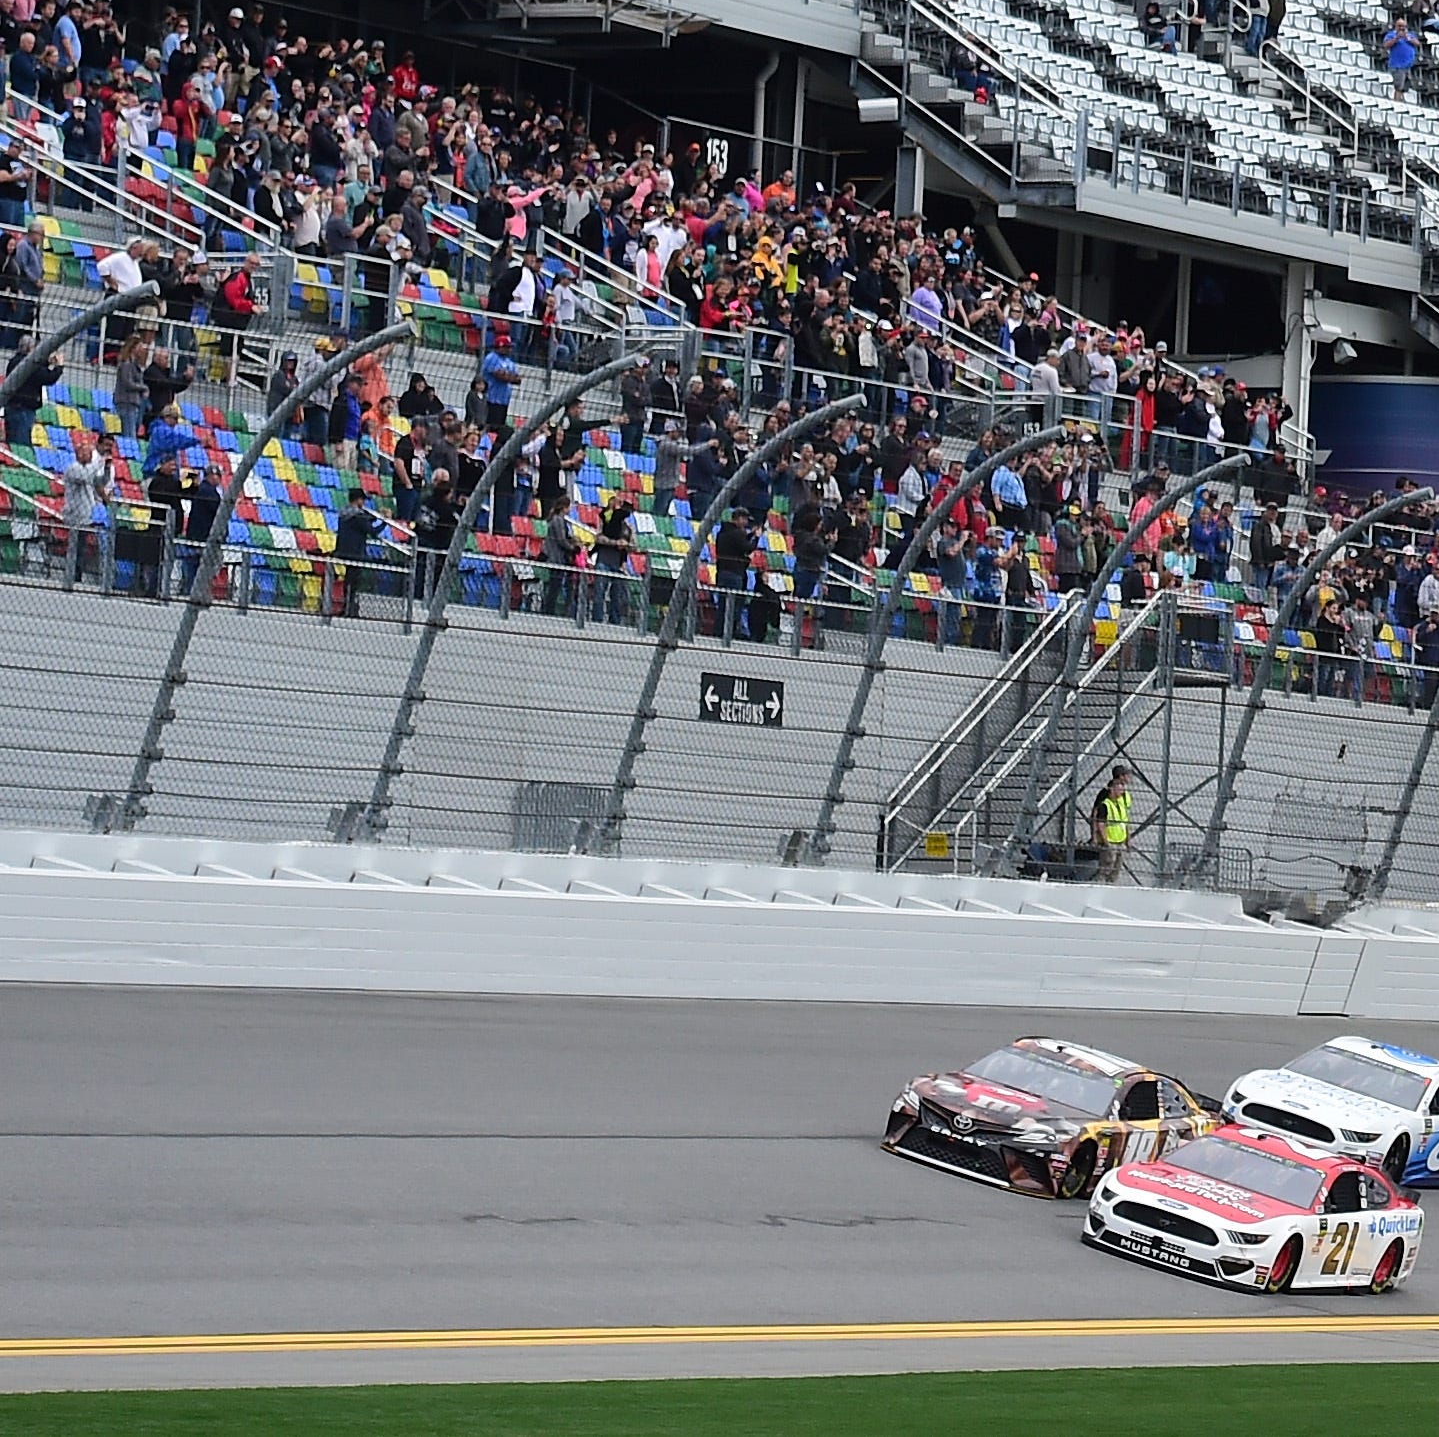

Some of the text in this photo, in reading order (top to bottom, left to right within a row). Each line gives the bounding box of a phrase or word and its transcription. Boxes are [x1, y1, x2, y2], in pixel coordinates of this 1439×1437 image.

[706, 137, 729, 175] 153
[732, 678, 750, 702] ALL
[720, 699, 765, 725] SECTIONS
[1119, 1237, 1190, 1268] MUSTANG
[1319, 1221, 1361, 1276] 21
